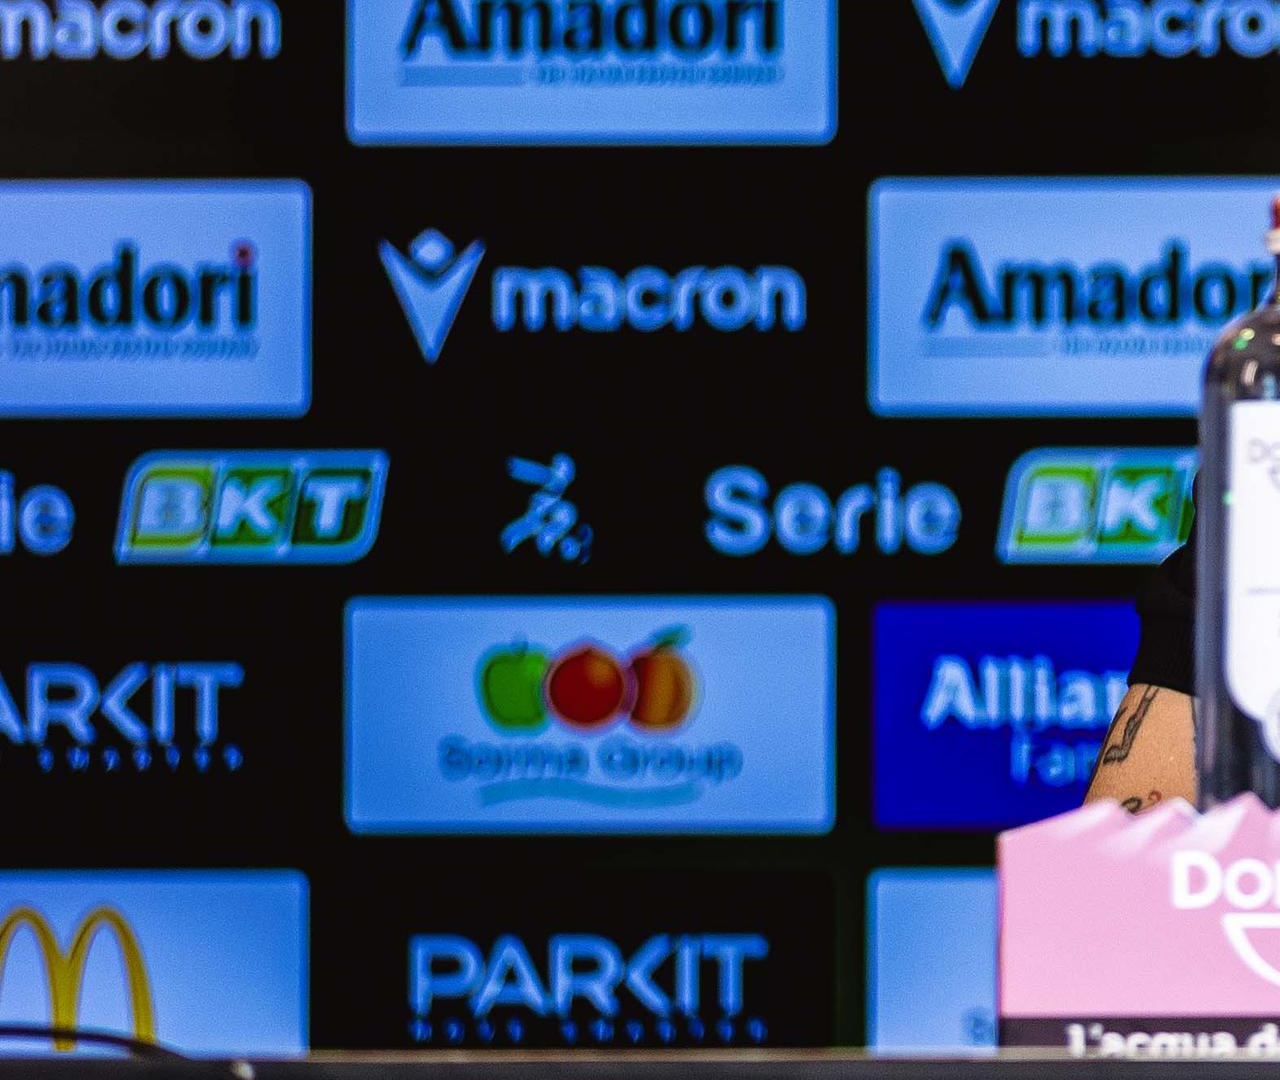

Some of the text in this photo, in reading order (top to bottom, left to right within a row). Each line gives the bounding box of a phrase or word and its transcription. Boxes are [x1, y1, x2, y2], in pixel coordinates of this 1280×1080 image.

[493, 267, 806, 330] macron
[138, 476, 366, 542] BKT
[706, 467, 960, 554] Serie
[408, 936, 770, 1018] PARKIT
